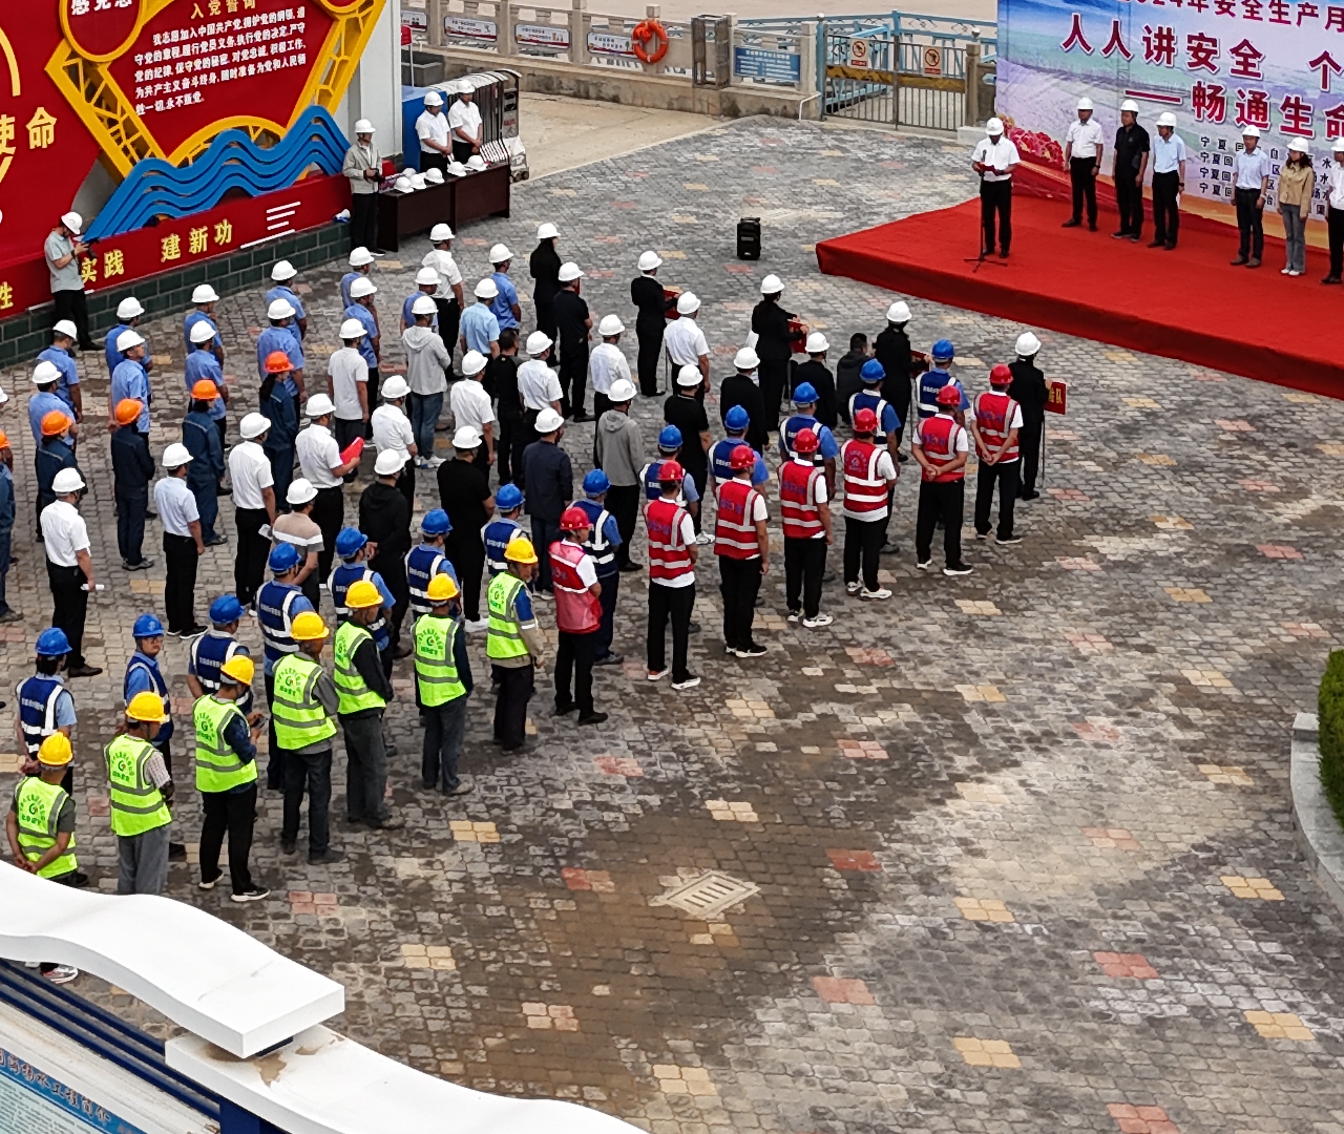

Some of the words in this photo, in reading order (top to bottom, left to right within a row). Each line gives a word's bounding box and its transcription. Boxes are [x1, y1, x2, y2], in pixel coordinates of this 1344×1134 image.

[1061, 13, 1264, 79] 人人讲安全
[80, 249, 124, 284] 实践
[160, 218, 233, 264] 建新功
